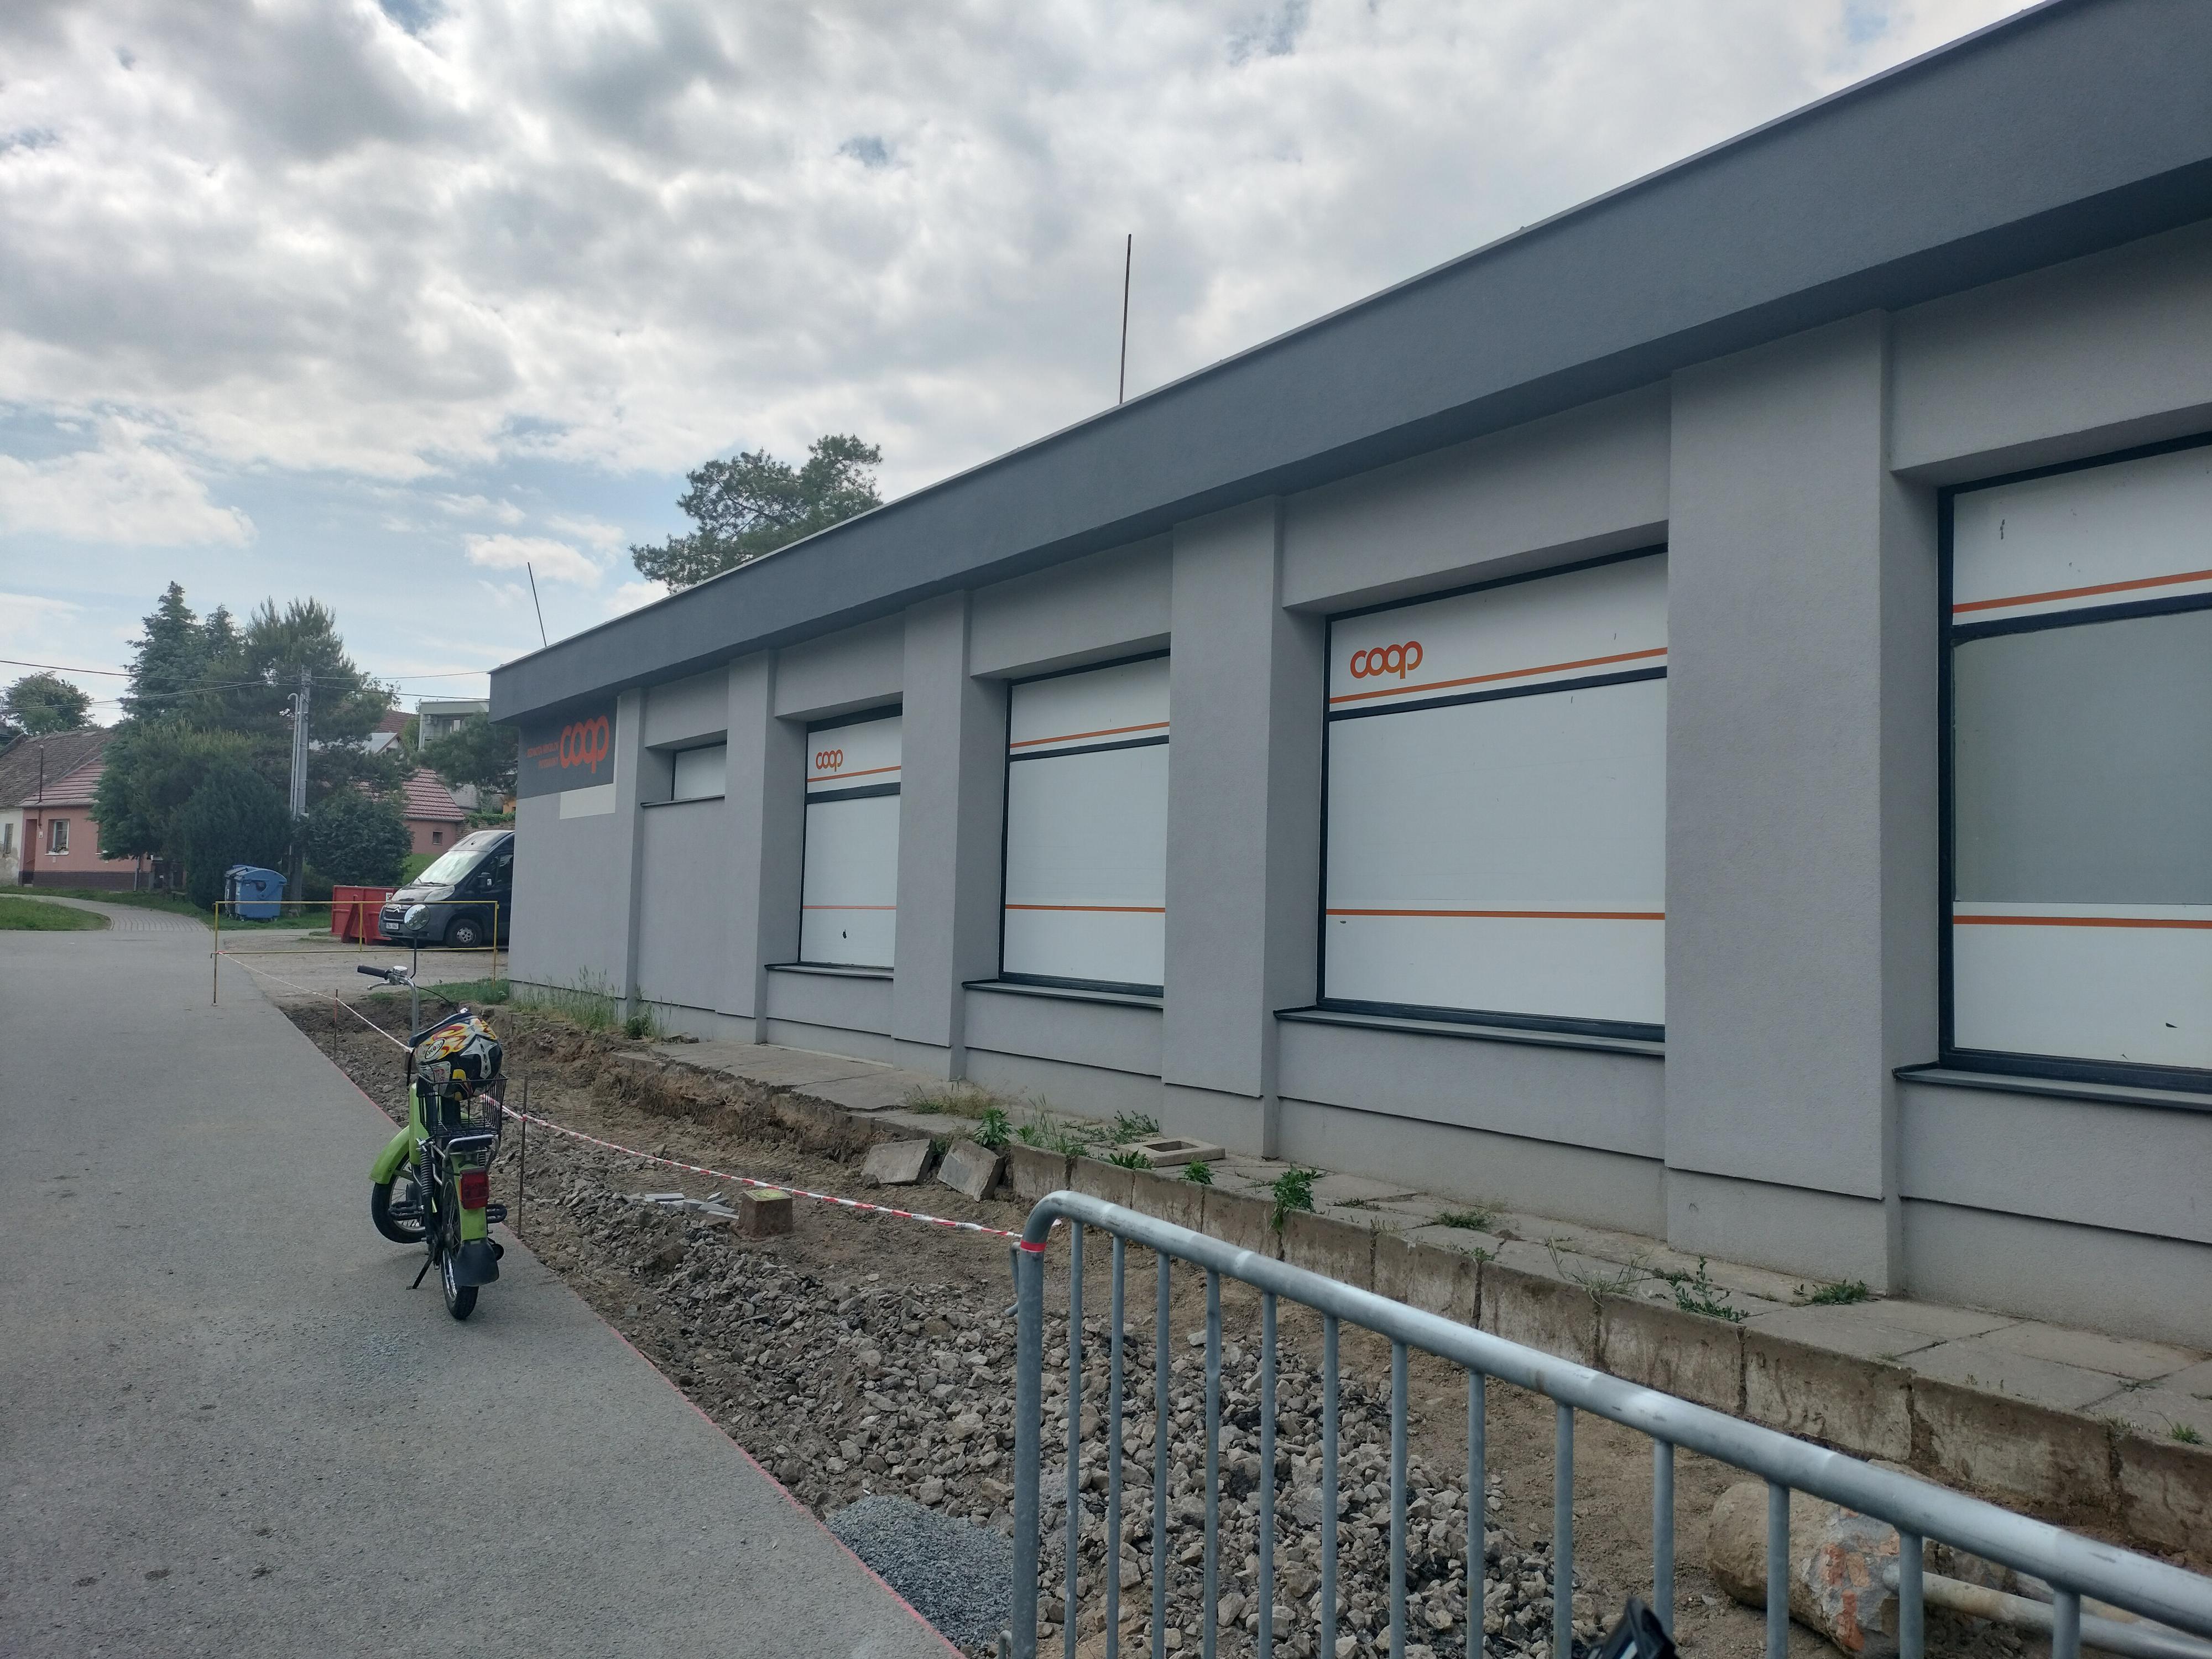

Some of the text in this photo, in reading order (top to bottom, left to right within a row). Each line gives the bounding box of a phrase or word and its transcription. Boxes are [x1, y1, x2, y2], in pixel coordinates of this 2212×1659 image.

[1350, 641, 1423, 679] coop
[560, 716, 609, 774] coop
[816, 749, 843, 772] coop
